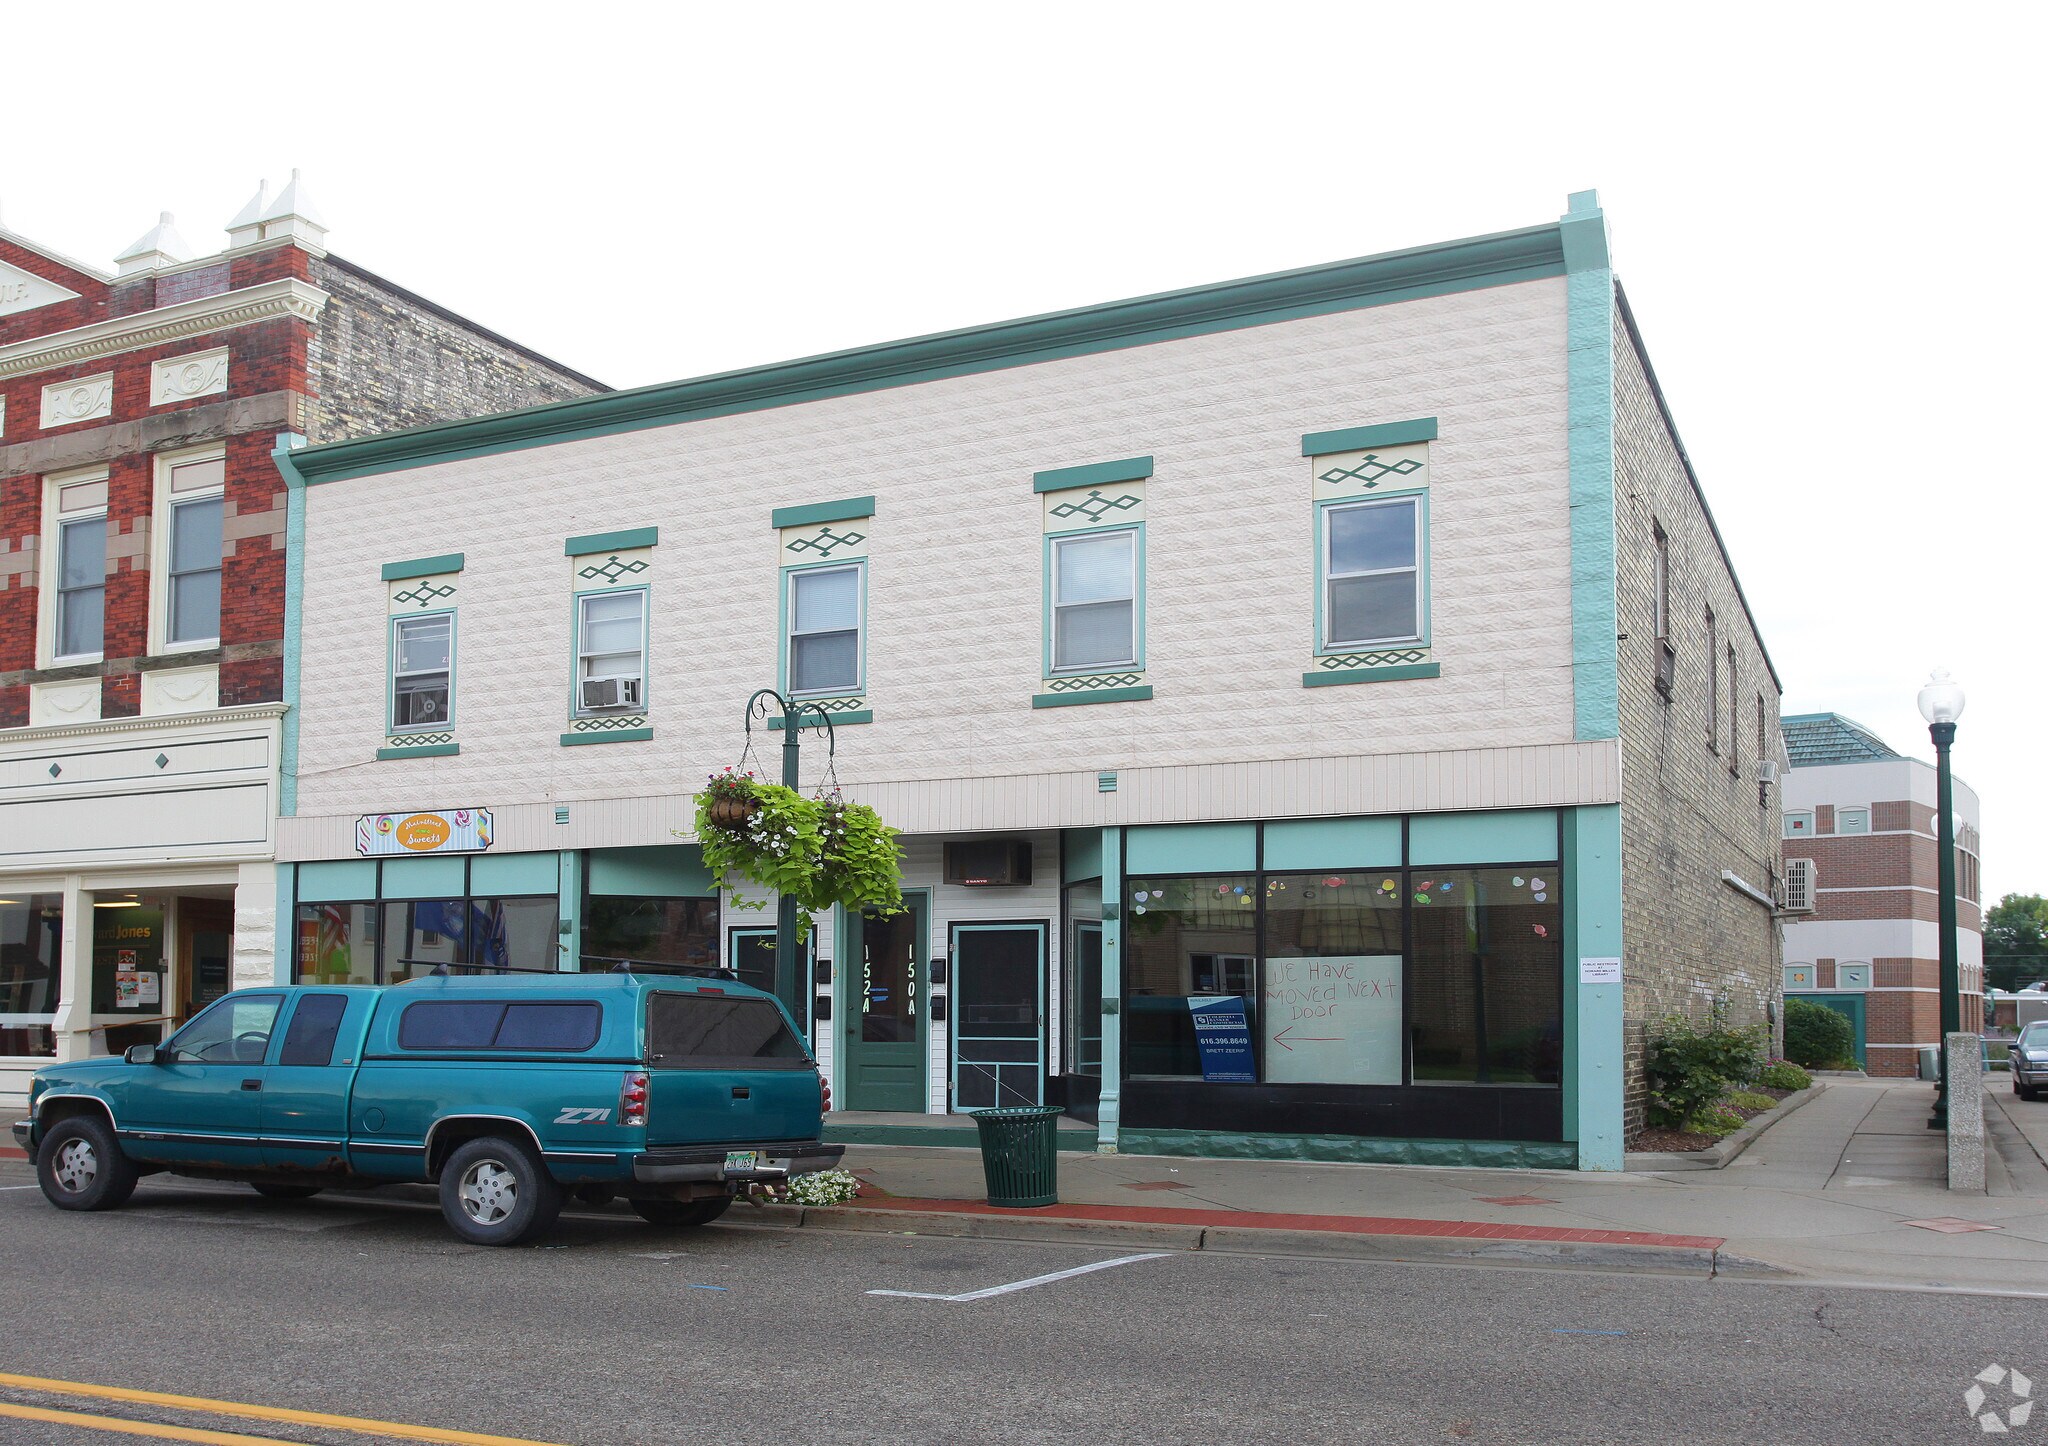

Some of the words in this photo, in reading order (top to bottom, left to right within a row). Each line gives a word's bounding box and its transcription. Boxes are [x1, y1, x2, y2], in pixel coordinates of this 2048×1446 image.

[406, 834, 441, 845] Sweets
[116, 926, 151, 940] Jones
[862, 944, 871, 1013] 152A
[907, 943, 915, 1015] 150A
[553, 1106, 612, 1124] Z71
